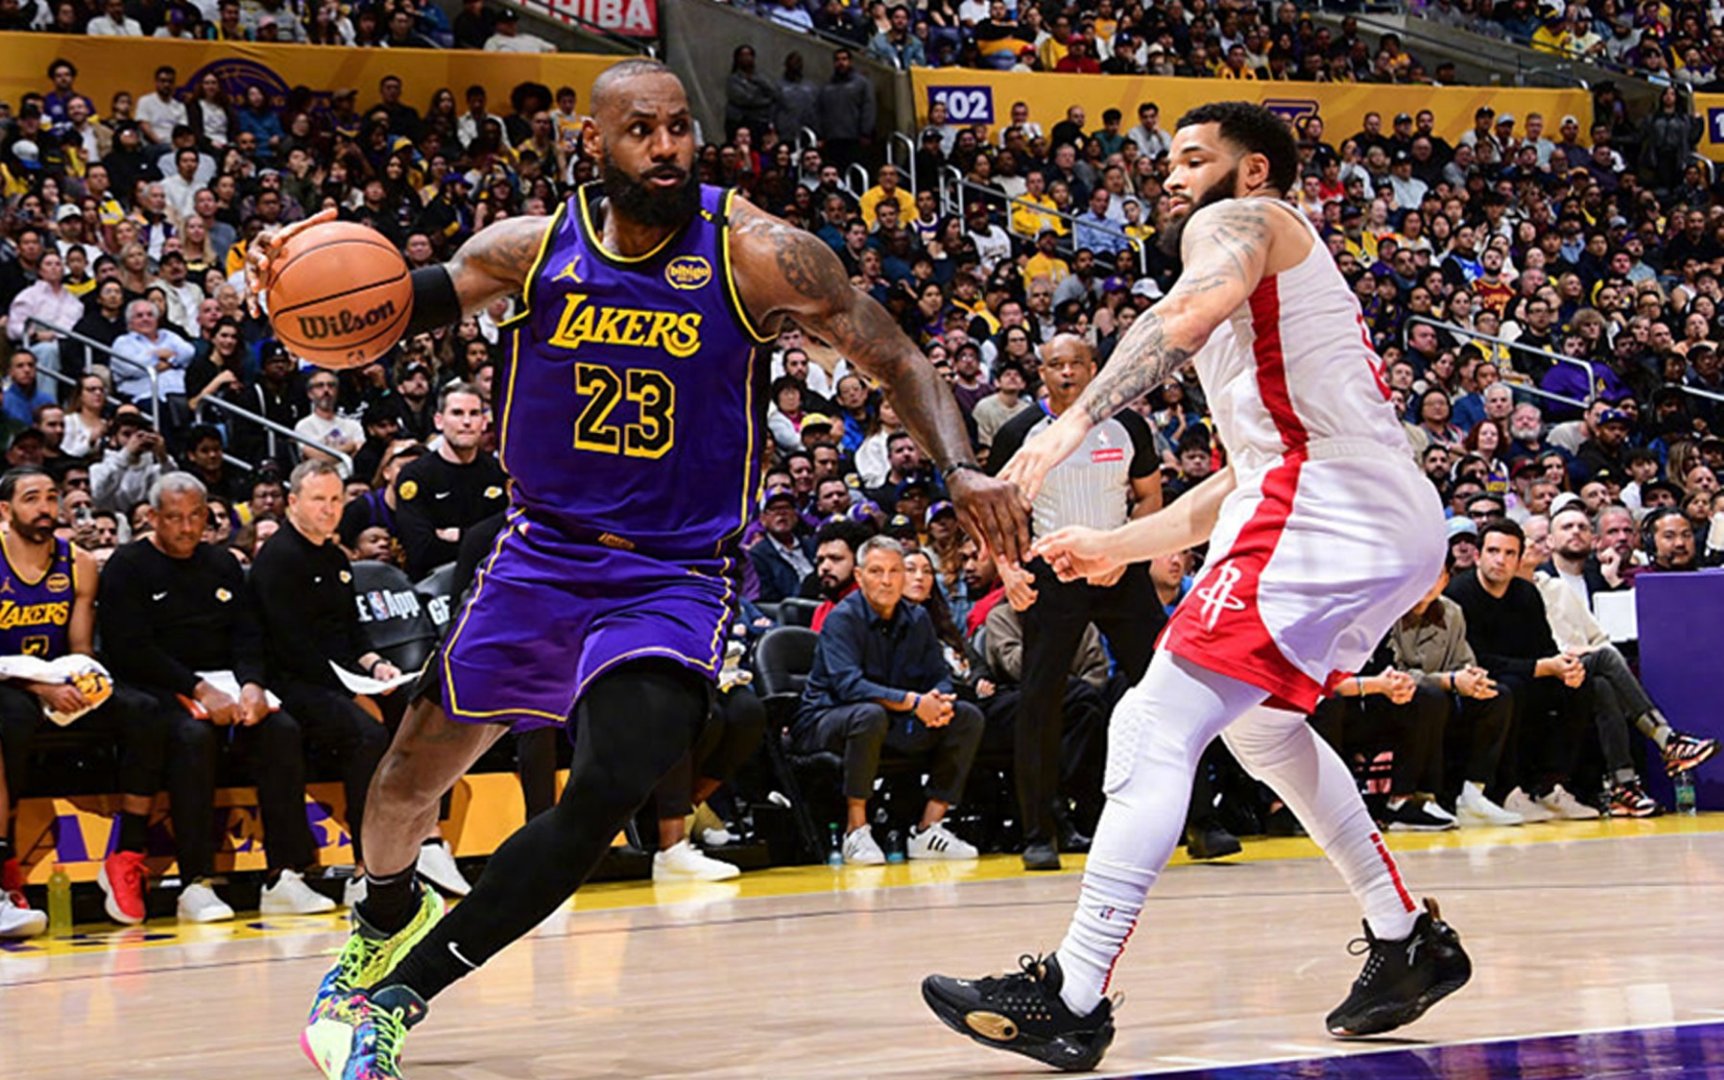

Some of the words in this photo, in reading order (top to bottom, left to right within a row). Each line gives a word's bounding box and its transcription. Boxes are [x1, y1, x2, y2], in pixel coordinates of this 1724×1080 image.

[297, 300, 395, 339] Wilson
[548, 293, 702, 357] LAKERS
[574, 362, 675, 459] 23
[0, 601, 69, 630] LAKERS
